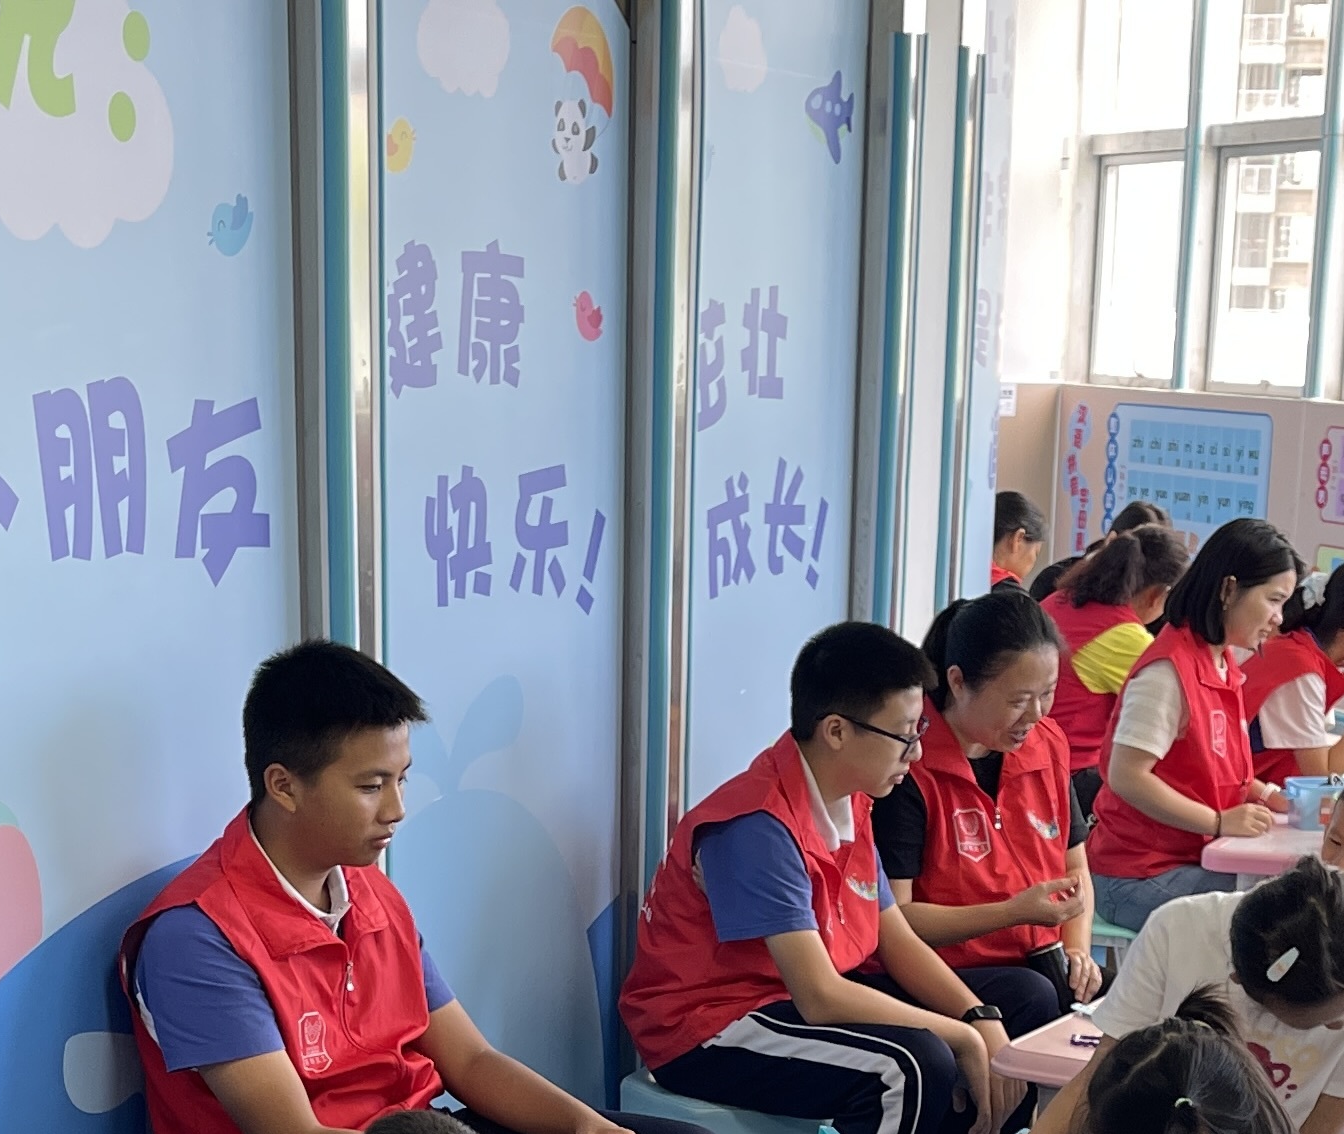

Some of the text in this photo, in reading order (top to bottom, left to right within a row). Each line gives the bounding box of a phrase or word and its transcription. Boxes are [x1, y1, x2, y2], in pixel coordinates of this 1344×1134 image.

[387, 239, 525, 399] 健康
[424, 464, 605, 615] 快乐!
[706, 456, 829, 600] 成长!
